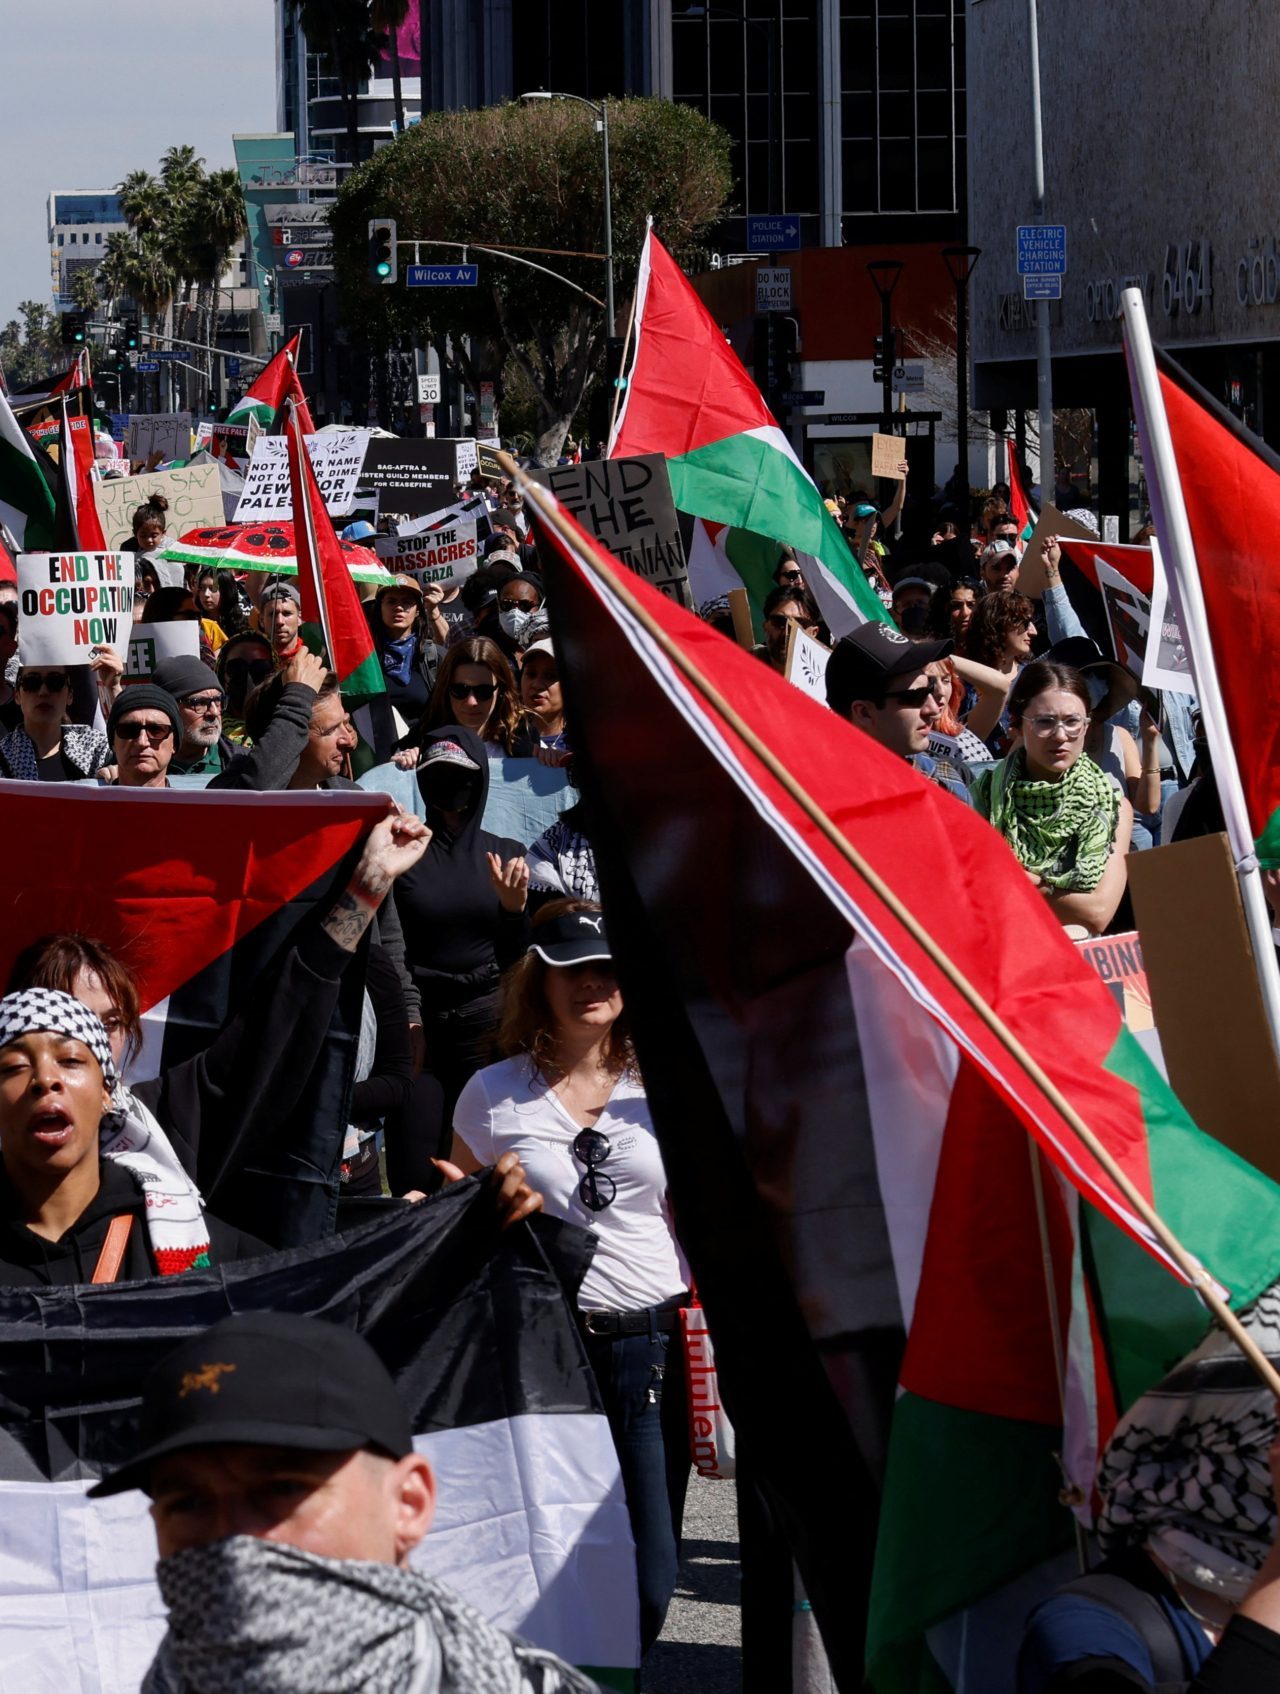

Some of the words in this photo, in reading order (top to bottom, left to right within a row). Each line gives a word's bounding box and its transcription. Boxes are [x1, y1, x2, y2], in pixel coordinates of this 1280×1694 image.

[752, 222, 783, 231] POLICE
[752, 235, 785, 243] STATION
[1020, 229, 1063, 239] ELECTRIC
[1023, 240, 1060, 250] VEHICLE
[1019, 250, 1065, 260] CHARGING
[1023, 261, 1061, 271] STATION
[414, 270, 451, 281] Wilcox
[457, 271, 471, 280] Av
[757, 273, 770, 284] DO
[773, 273, 790, 284] NOT
[1162, 239, 1213, 315] 6464
[757, 287, 790, 298] BLOCK
[422, 390, 438, 400] 30
[214, 426, 229, 435] FREE
[251, 463, 277, 471] NOT
[327, 456, 361, 467] NAME
[377, 463, 420, 471] SAG-AFTRA
[874, 461, 899, 472] RAFA
[248, 473, 274, 482] NOT
[329, 467, 359, 477] DIME
[101, 479, 167, 506] JEWS
[170, 467, 215, 493] SAY
[250, 483, 292, 496] JEW
[320, 478, 346, 492] OR
[548, 460, 653, 503] END
[239, 491, 350, 509] PALESNE!
[397, 537, 431, 553] STOP
[434, 529, 457, 546] THE
[380, 538, 476, 573] MASSACRES
[49, 555, 89, 583] END
[94, 554, 123, 581] THE
[422, 565, 454, 584] GAZA
[22, 586, 133, 617] OCCUPATION
[74, 617, 117, 646] NOW
